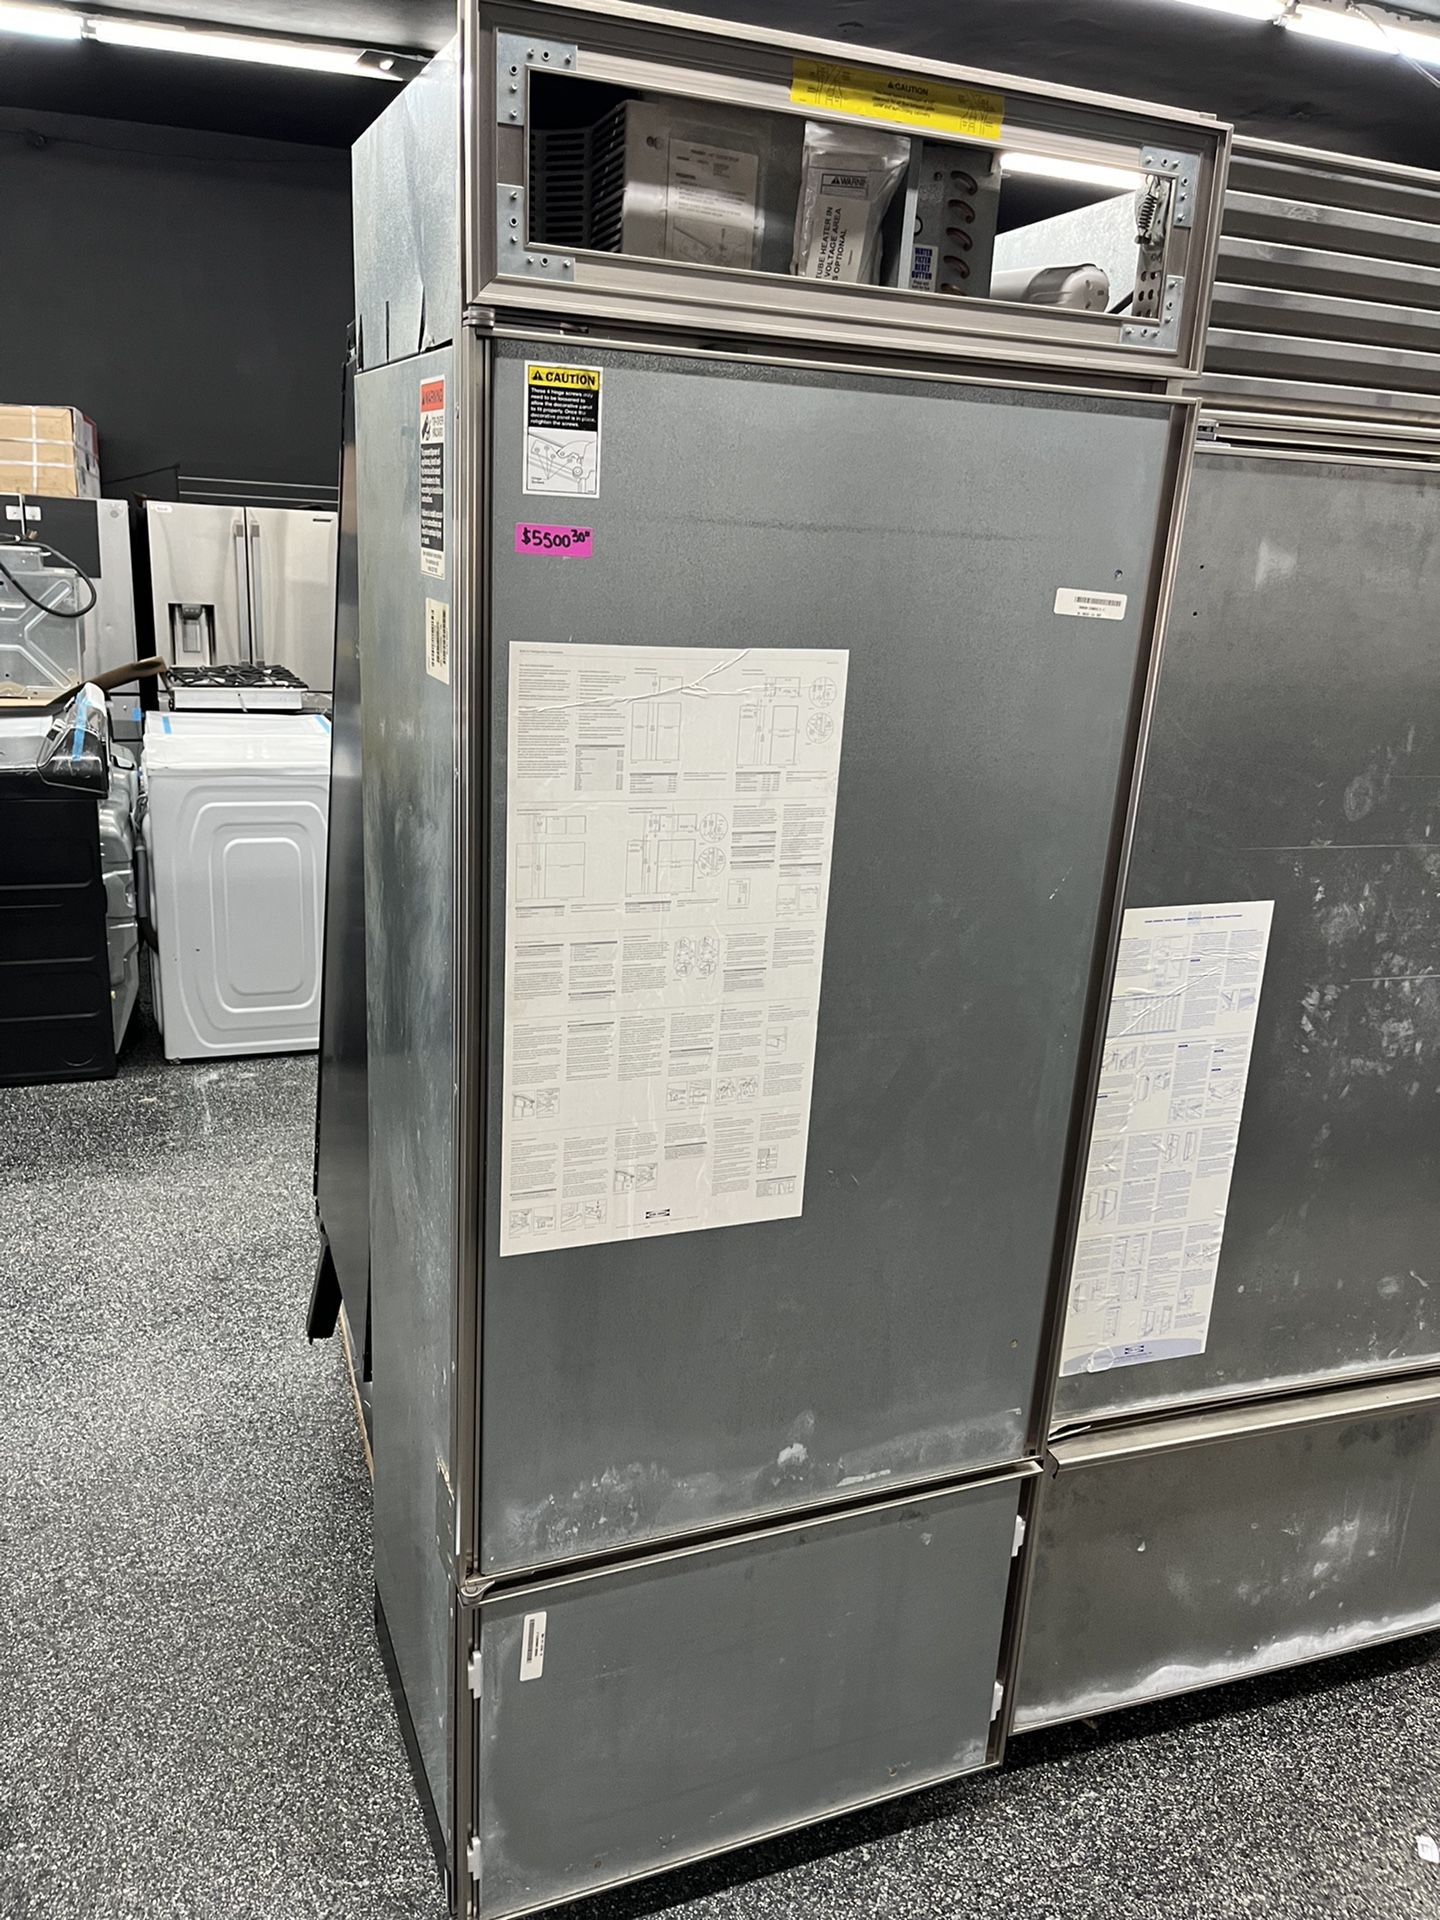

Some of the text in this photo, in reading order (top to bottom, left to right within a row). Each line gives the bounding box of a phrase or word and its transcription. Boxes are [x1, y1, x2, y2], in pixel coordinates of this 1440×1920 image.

[895, 82, 929, 96] CAUTION
[815, 206, 833, 279] TUBE HEATER IN
[823, 207, 842, 278] VOLTAGE AREA
[833, 229, 847, 274] OPTIONAL
[915, 247, 933, 257] WATER
[915, 255, 931, 264] FILTER
[915, 263, 930, 272] RESET
[911, 270, 932, 280] BUTTON
[546, 372, 595, 386] CAUTION
[521, 527, 571, 548] $5500
